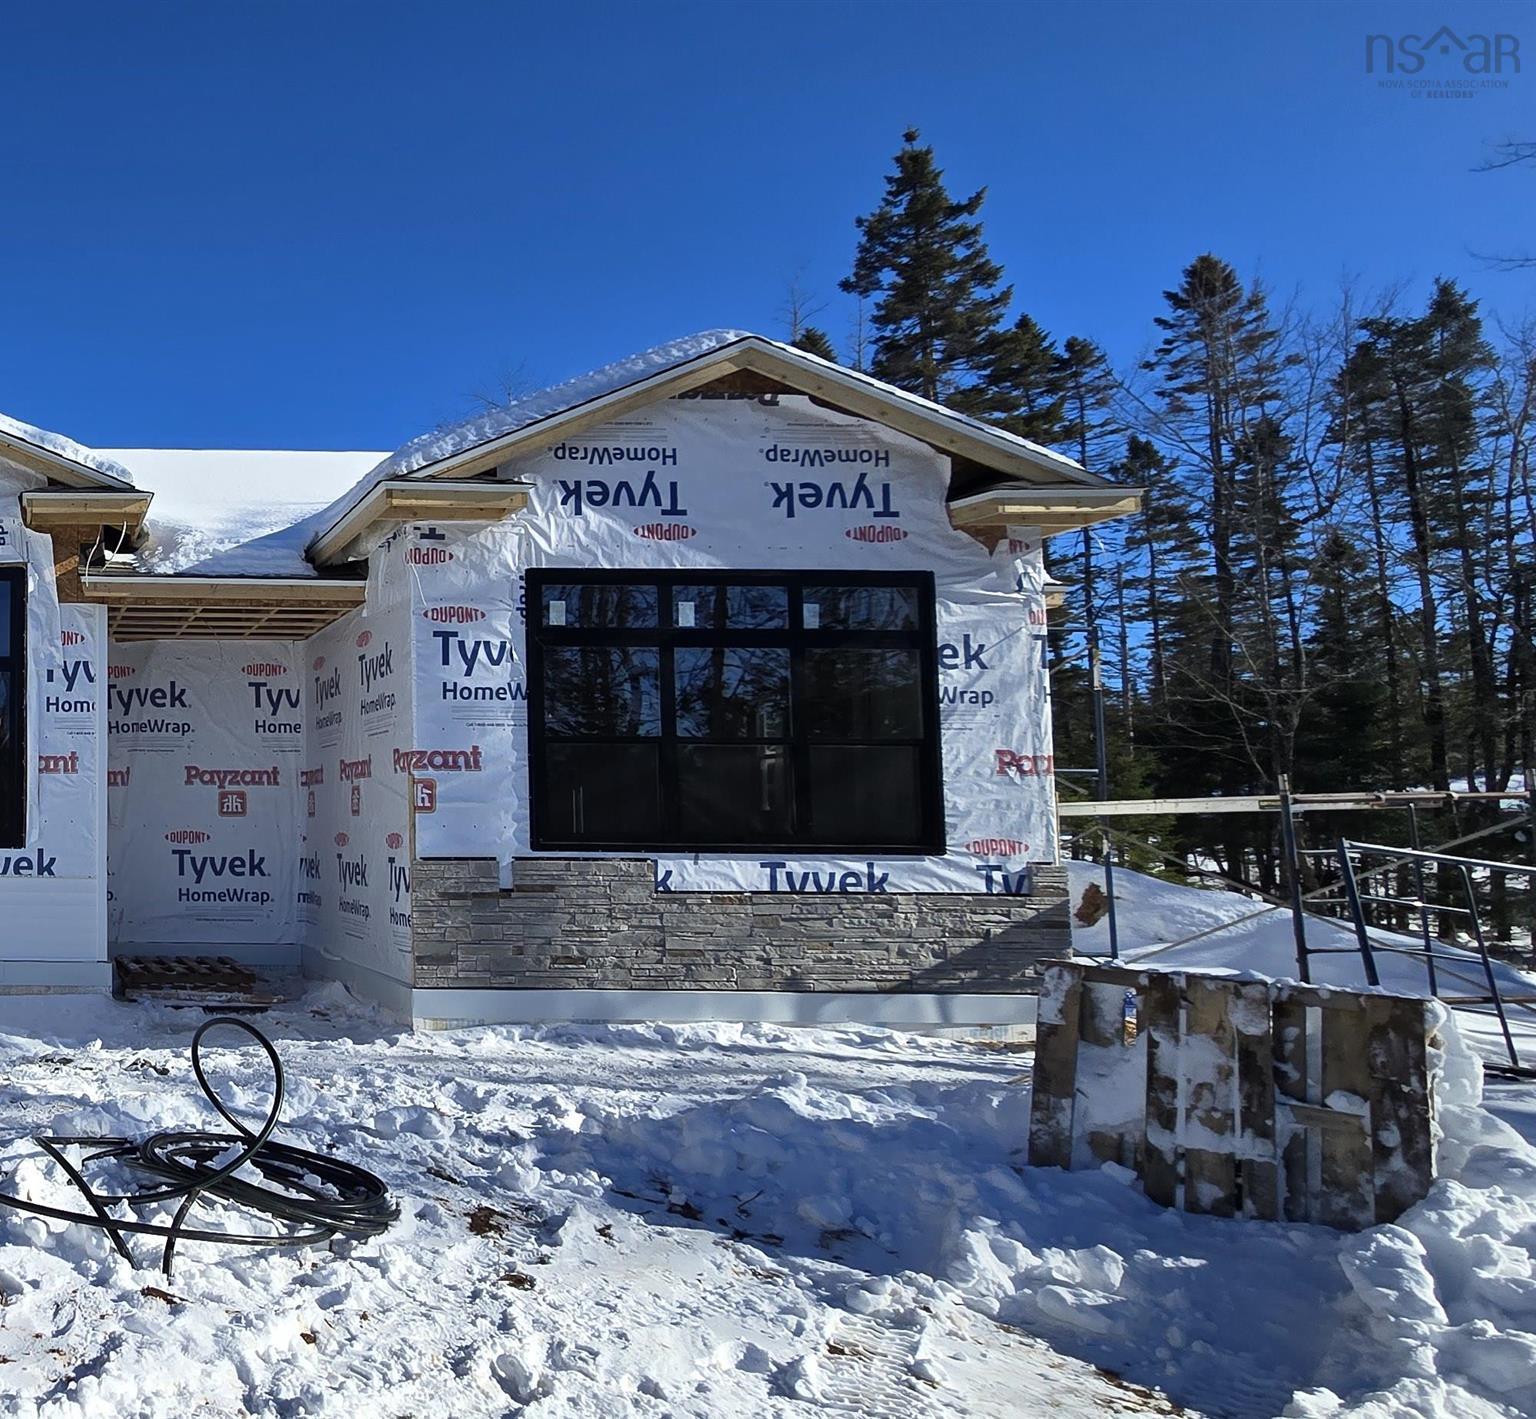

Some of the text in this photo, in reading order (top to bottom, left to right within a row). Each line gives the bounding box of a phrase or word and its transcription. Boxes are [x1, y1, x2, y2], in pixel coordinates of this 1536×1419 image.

[553, 442, 678, 466] HomeWrap
[765, 447, 890, 467] HomeWrap
[560, 470, 688, 516] Tyvek
[770, 473, 901, 518] Tyvek
[640, 523, 689, 541] DUPONT
[853, 525, 901, 543] DUPONT
[430, 606, 480, 623] DUPONT
[432, 630, 514, 677] Tyv
[107, 666, 131, 679] PONT
[246, 663, 283, 677] DUPONT
[358, 641, 393, 693] Tyvek
[248, 682, 301, 716] Tyv
[314, 667, 342, 711] Tyvek
[442, 681, 528, 701] HomeW
[940, 687, 994, 707] Wrap
[108, 719, 191, 736] HomeWrap
[254, 719, 302, 734] Home
[184, 766, 280, 789] Payzant
[169, 830, 206, 844] DUPONT
[972, 839, 1023, 857] DUPONT
[172, 849, 266, 884] Tyvek
[337, 853, 368, 892] Tyvek
[388, 857, 411, 902] Tyv
[178, 888, 271, 905] HomeWrap
[389, 907, 412, 928] Home
